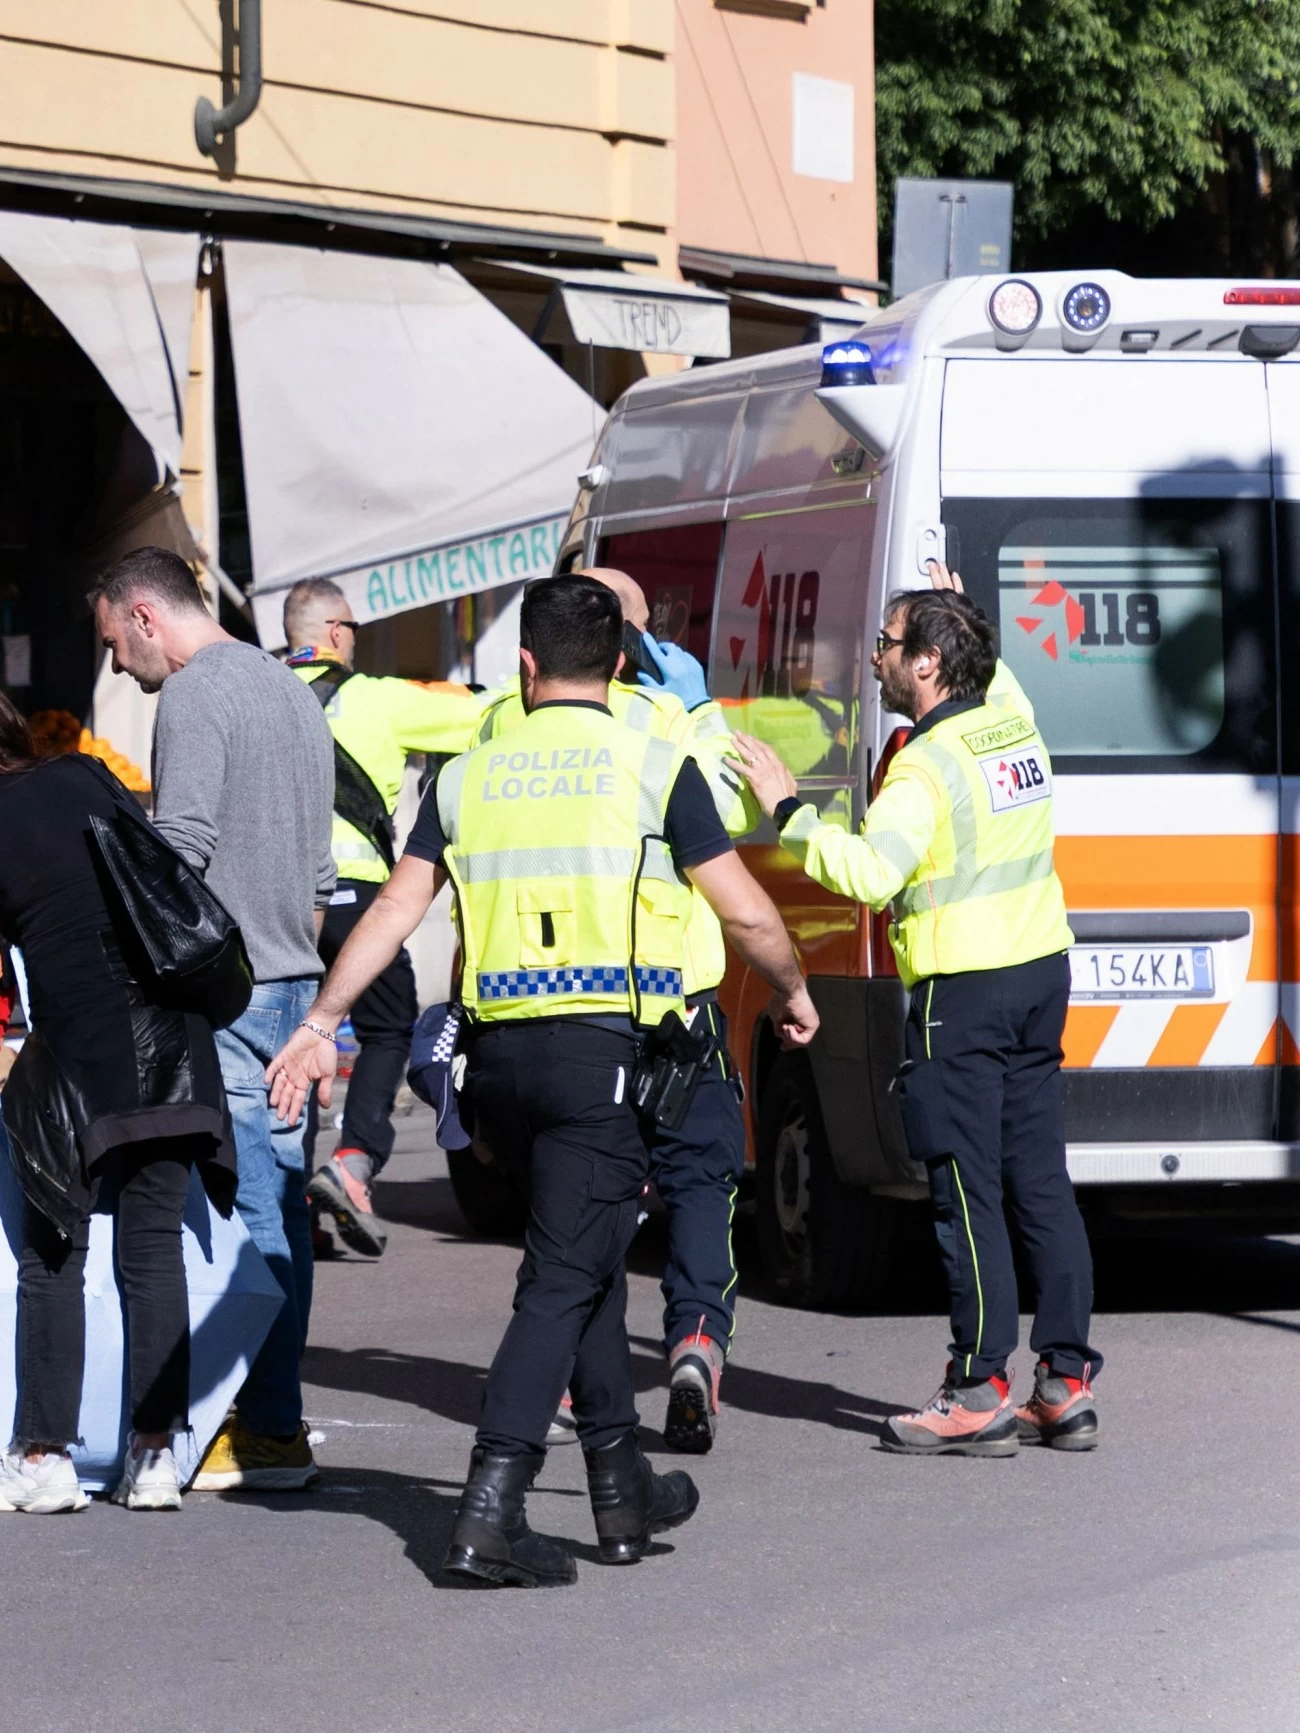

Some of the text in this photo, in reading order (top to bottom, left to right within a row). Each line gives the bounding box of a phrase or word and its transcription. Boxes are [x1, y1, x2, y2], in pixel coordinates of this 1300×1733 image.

[366, 522, 560, 613] ALIMENTARI
[762, 570, 820, 699] 118
[1079, 593, 1161, 646] 118
[488, 748, 613, 773] POLIZIA
[1011, 758, 1044, 791] 118
[482, 774, 616, 801] LOCALE
[1090, 954, 1189, 987] 154KA
